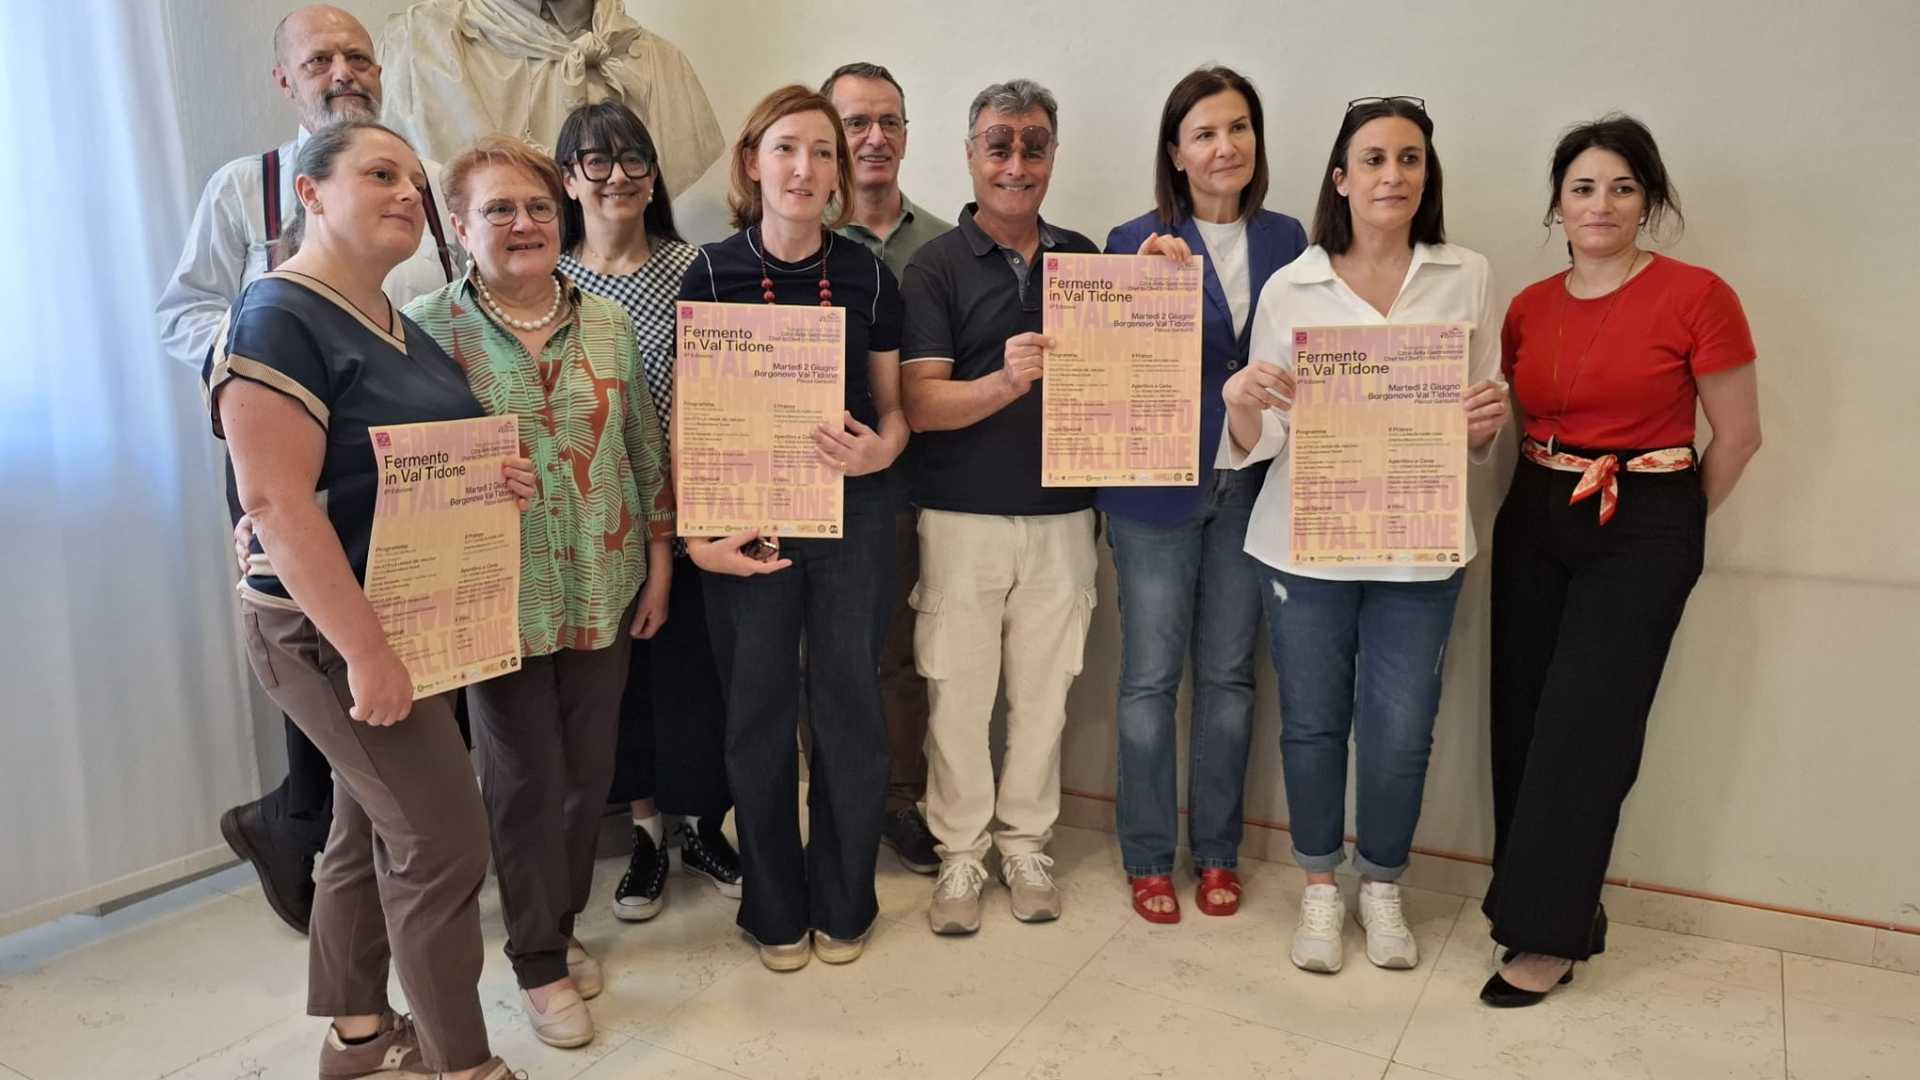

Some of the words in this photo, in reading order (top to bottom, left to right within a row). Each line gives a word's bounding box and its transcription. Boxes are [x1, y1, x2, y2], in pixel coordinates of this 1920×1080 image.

[1049, 277, 1112, 290] Fermento
[1050, 291, 1060, 301] in
[1064, 291, 1084, 302] Val
[1087, 290, 1132, 302] Tidone
[1114, 320, 1154, 328] Borgonovo
[1156, 320, 1168, 328] Val
[1170, 320, 1195, 328] Tidone
[683, 325, 752, 340] Fermento
[684, 340, 696, 350] in
[700, 339, 722, 351] Val
[726, 340, 774, 352] Tidone
[1297, 350, 1367, 364] Fermento
[754, 370, 796, 378] Borgonovo
[798, 370, 810, 378] Val
[1297, 365, 1309, 376] in
[1312, 364, 1334, 376] Val
[1340, 362, 1390, 375] Tidone
[1430, 383, 1461, 392] Giugno
[1368, 392, 1414, 401] Borgonovo
[384, 452, 448, 470] Fermento
[385, 472, 397, 486] in
[400, 468, 422, 484] Val
[425, 464, 466, 480] Tidone
[450, 494, 484, 506] Borgonovo
